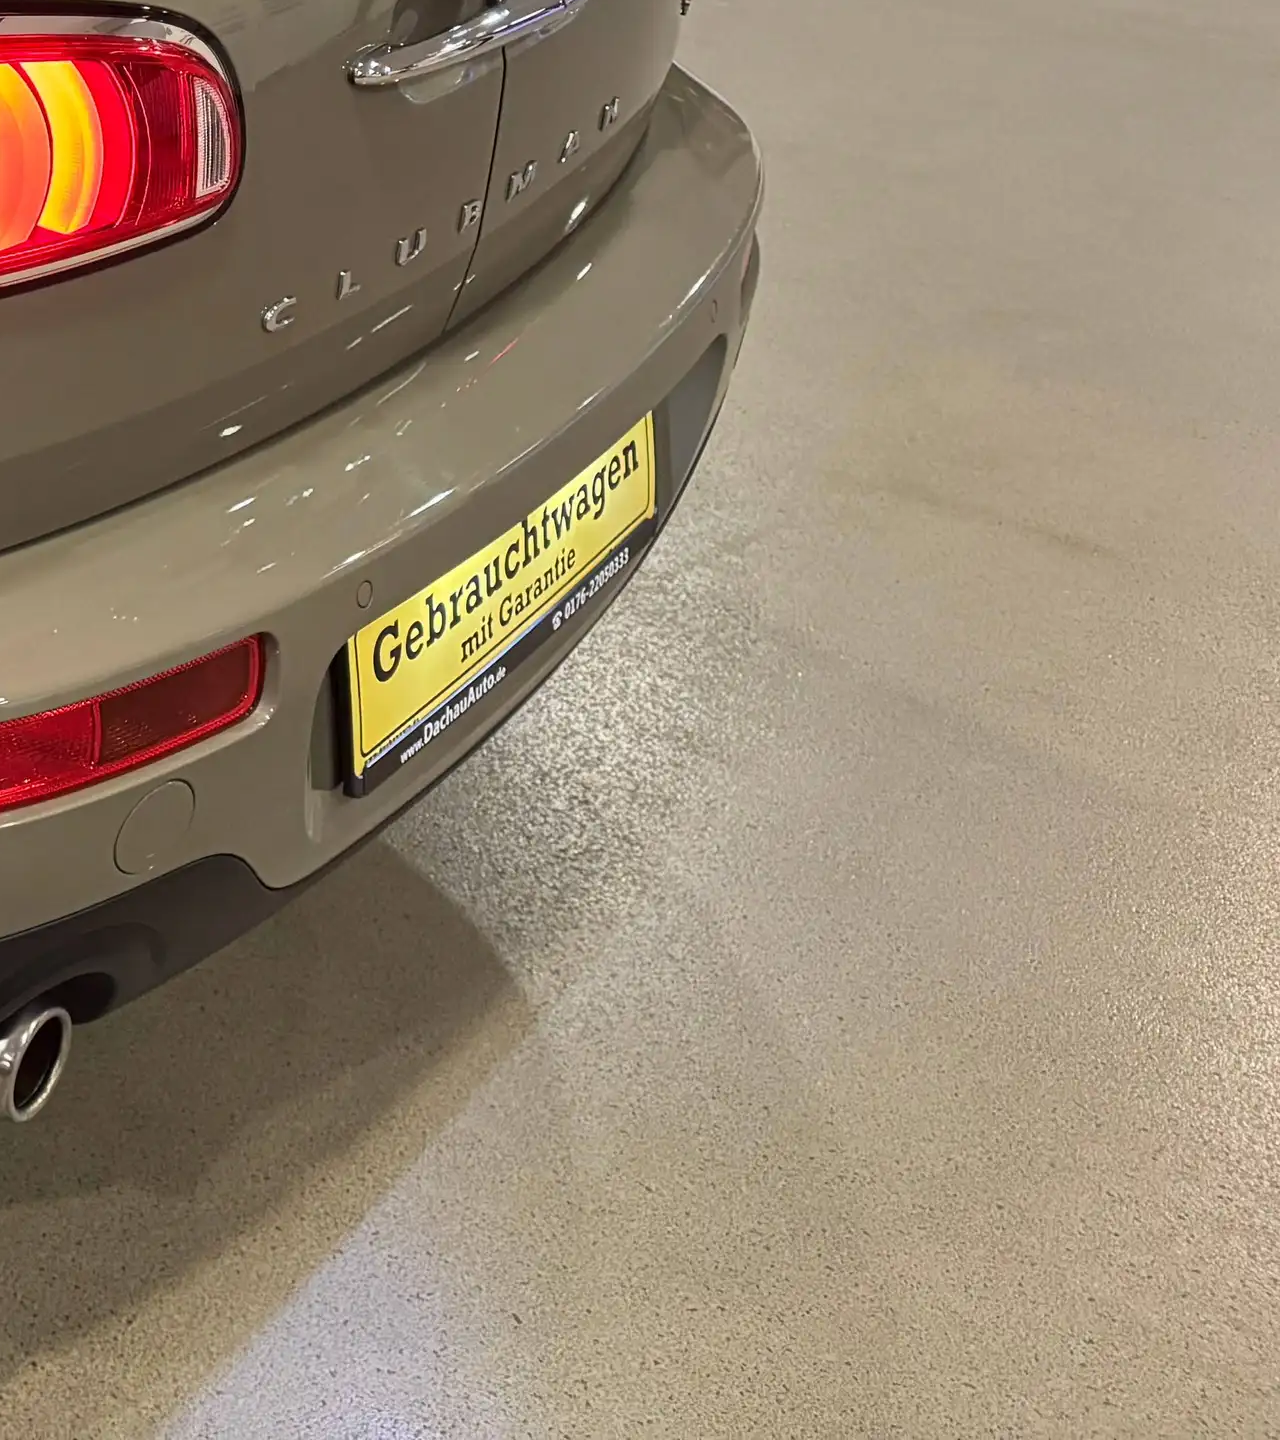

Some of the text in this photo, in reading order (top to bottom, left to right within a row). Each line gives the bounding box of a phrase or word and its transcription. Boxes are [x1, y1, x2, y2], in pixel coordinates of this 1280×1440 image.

[260, 96, 622, 334] CLUBMAN
[372, 438, 640, 684] Gebrauchtwagen
[399, 665, 507, 764] www.DachauAuto.de
[562, 546, 631, 621] 0176-22050333
[460, 547, 576, 663] mit Garantie
